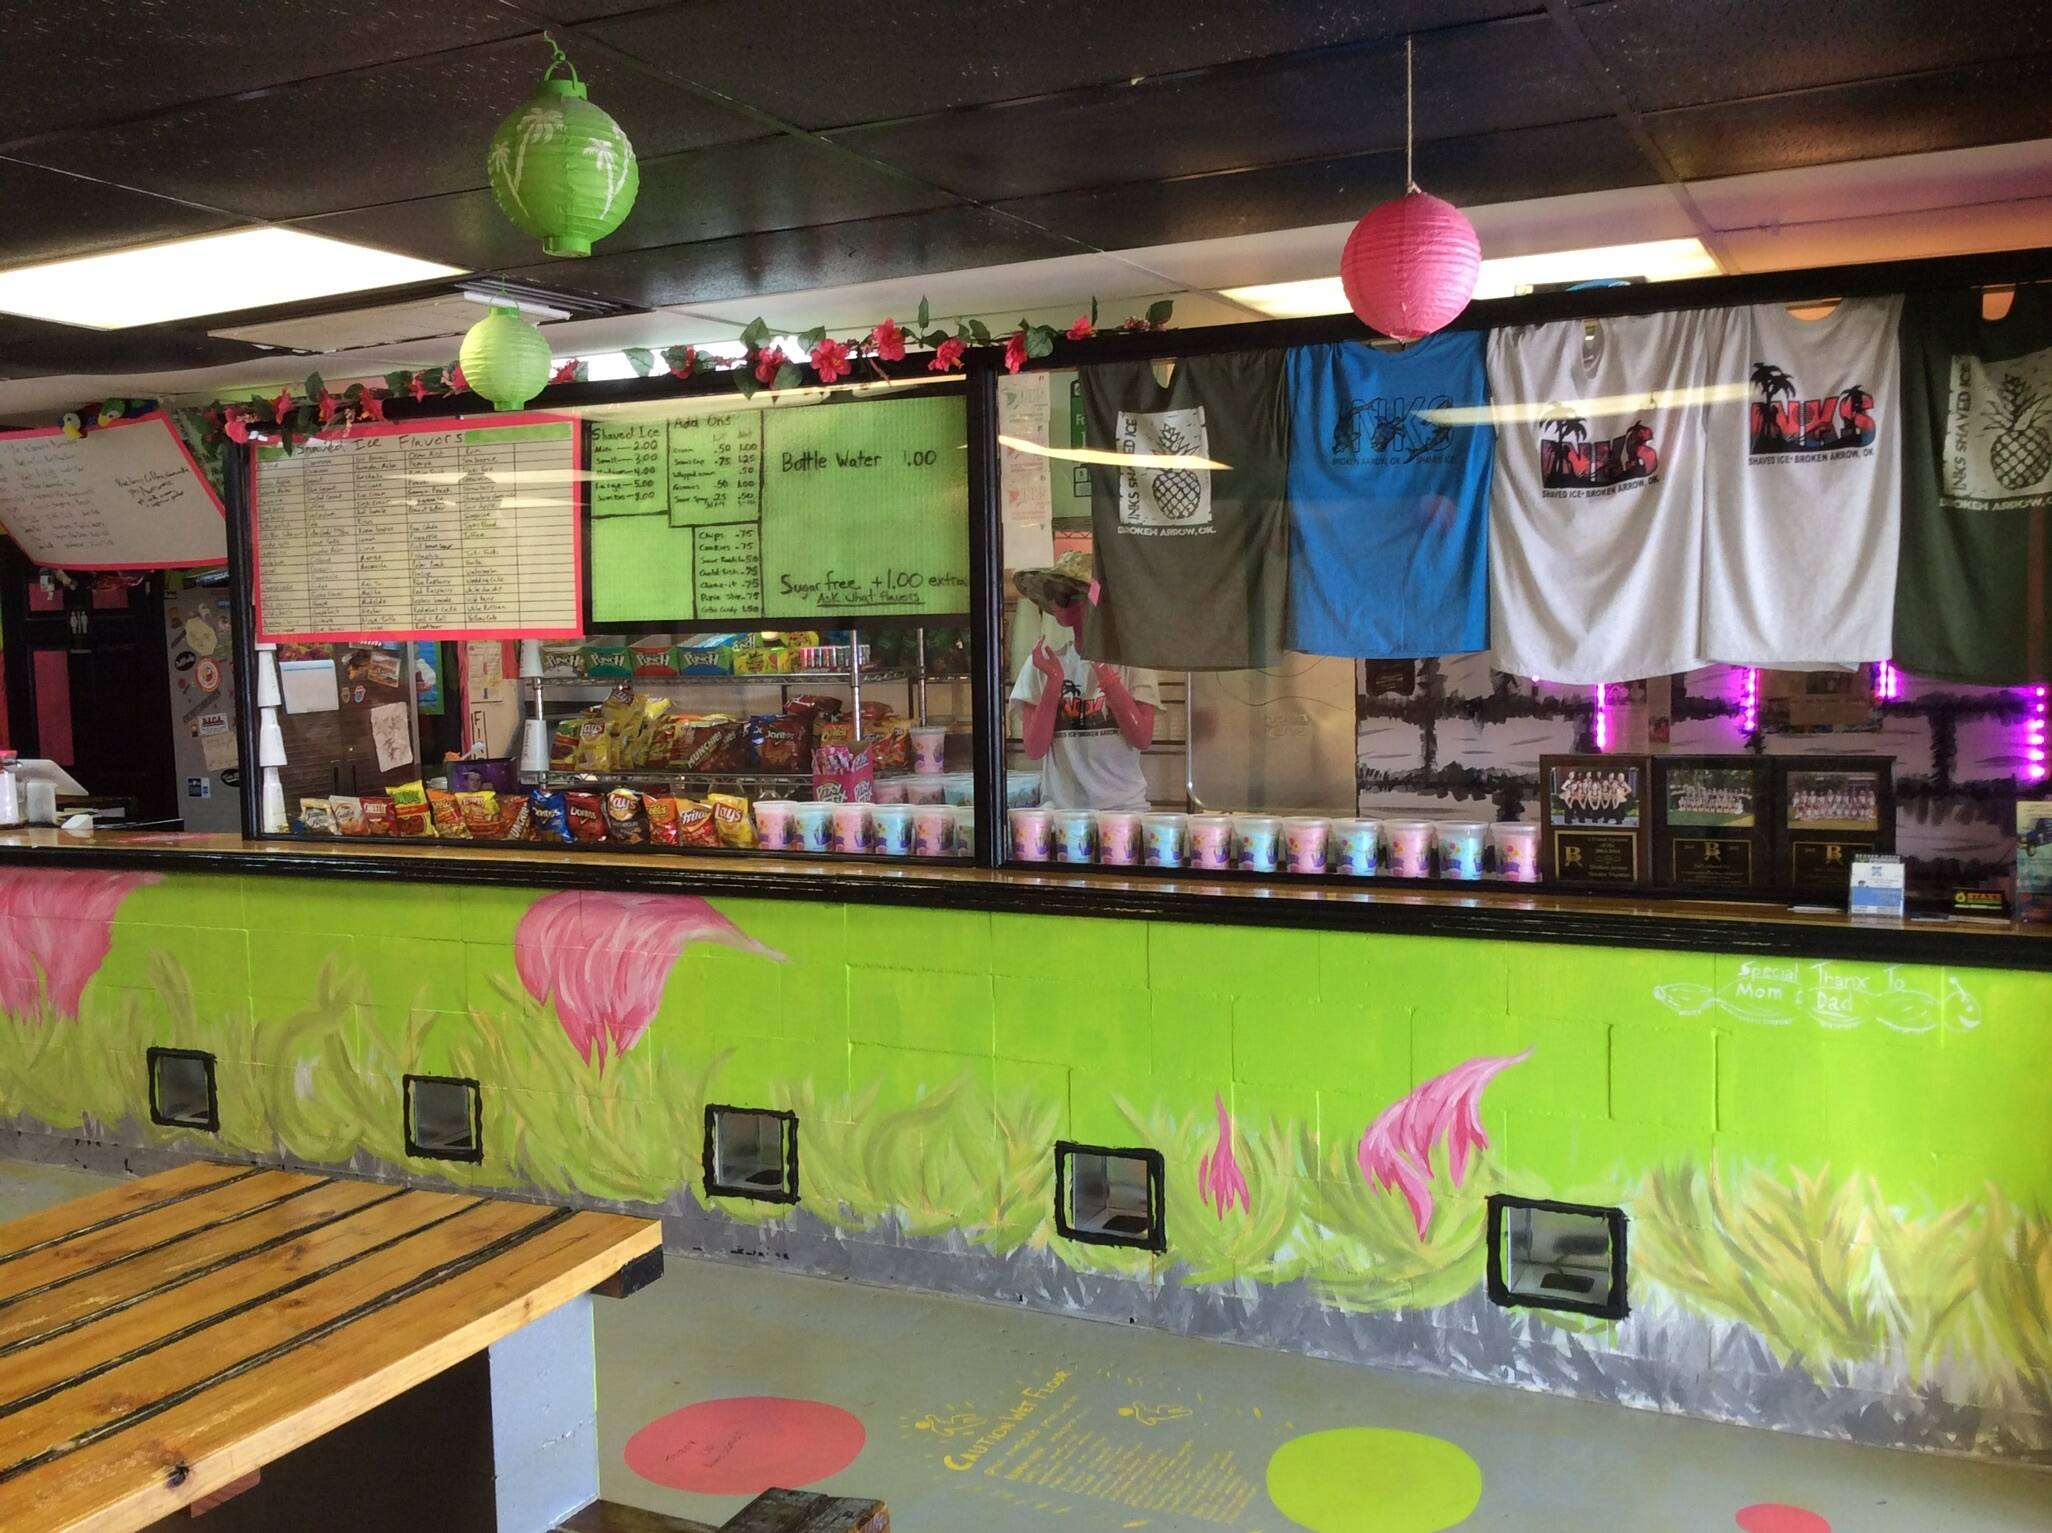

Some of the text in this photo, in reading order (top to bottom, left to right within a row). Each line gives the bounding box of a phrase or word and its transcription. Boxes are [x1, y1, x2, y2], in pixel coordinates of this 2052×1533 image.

[673, 417, 699, 429] Add
[1125, 419, 1137, 437] ICE
[1952, 362, 1971, 490] INKS SHAVED ICE
[592, 425, 661, 441] Shaved Ice
[352, 438, 382, 451] Ice
[398, 433, 463, 450] Flavors
[634, 440, 658, 450] 2.00
[714, 444, 731, 454] .50
[739, 443, 758, 452] 1.00
[596, 453, 658, 465] Small 3.00
[714, 456, 731, 466] .75
[738, 455, 756, 464] 1.25
[782, 450, 827, 472] Bottle
[836, 449, 882, 467] Water
[1794, 454, 1828, 464] BROKEN
[634, 467, 656, 477] 4.00
[595, 480, 655, 492] Large 5.00
[1542, 490, 1568, 498] SHAVED
[1586, 487, 1616, 498] BROKEN
[1127, 491, 1140, 520] INKS
[1939, 498, 1989, 511] BOKEN
[699, 530, 753, 541] Chips .75
[780, 568, 968, 600] Sugar free +1.00 extra
[817, 592, 838, 604] Ask
[590, 653, 625, 666] PUNCH
[636, 653, 670, 666] PUNCH
[683, 652, 719, 665] PUNCH
[570, 807, 597, 819] Doritos
[1738, 961, 1906, 991] Special Thanx To
[1736, 982, 1783, 1000] Mom
[1817, 991, 1854, 1014] Dad
[943, 1422, 1017, 1472] CAUTION
